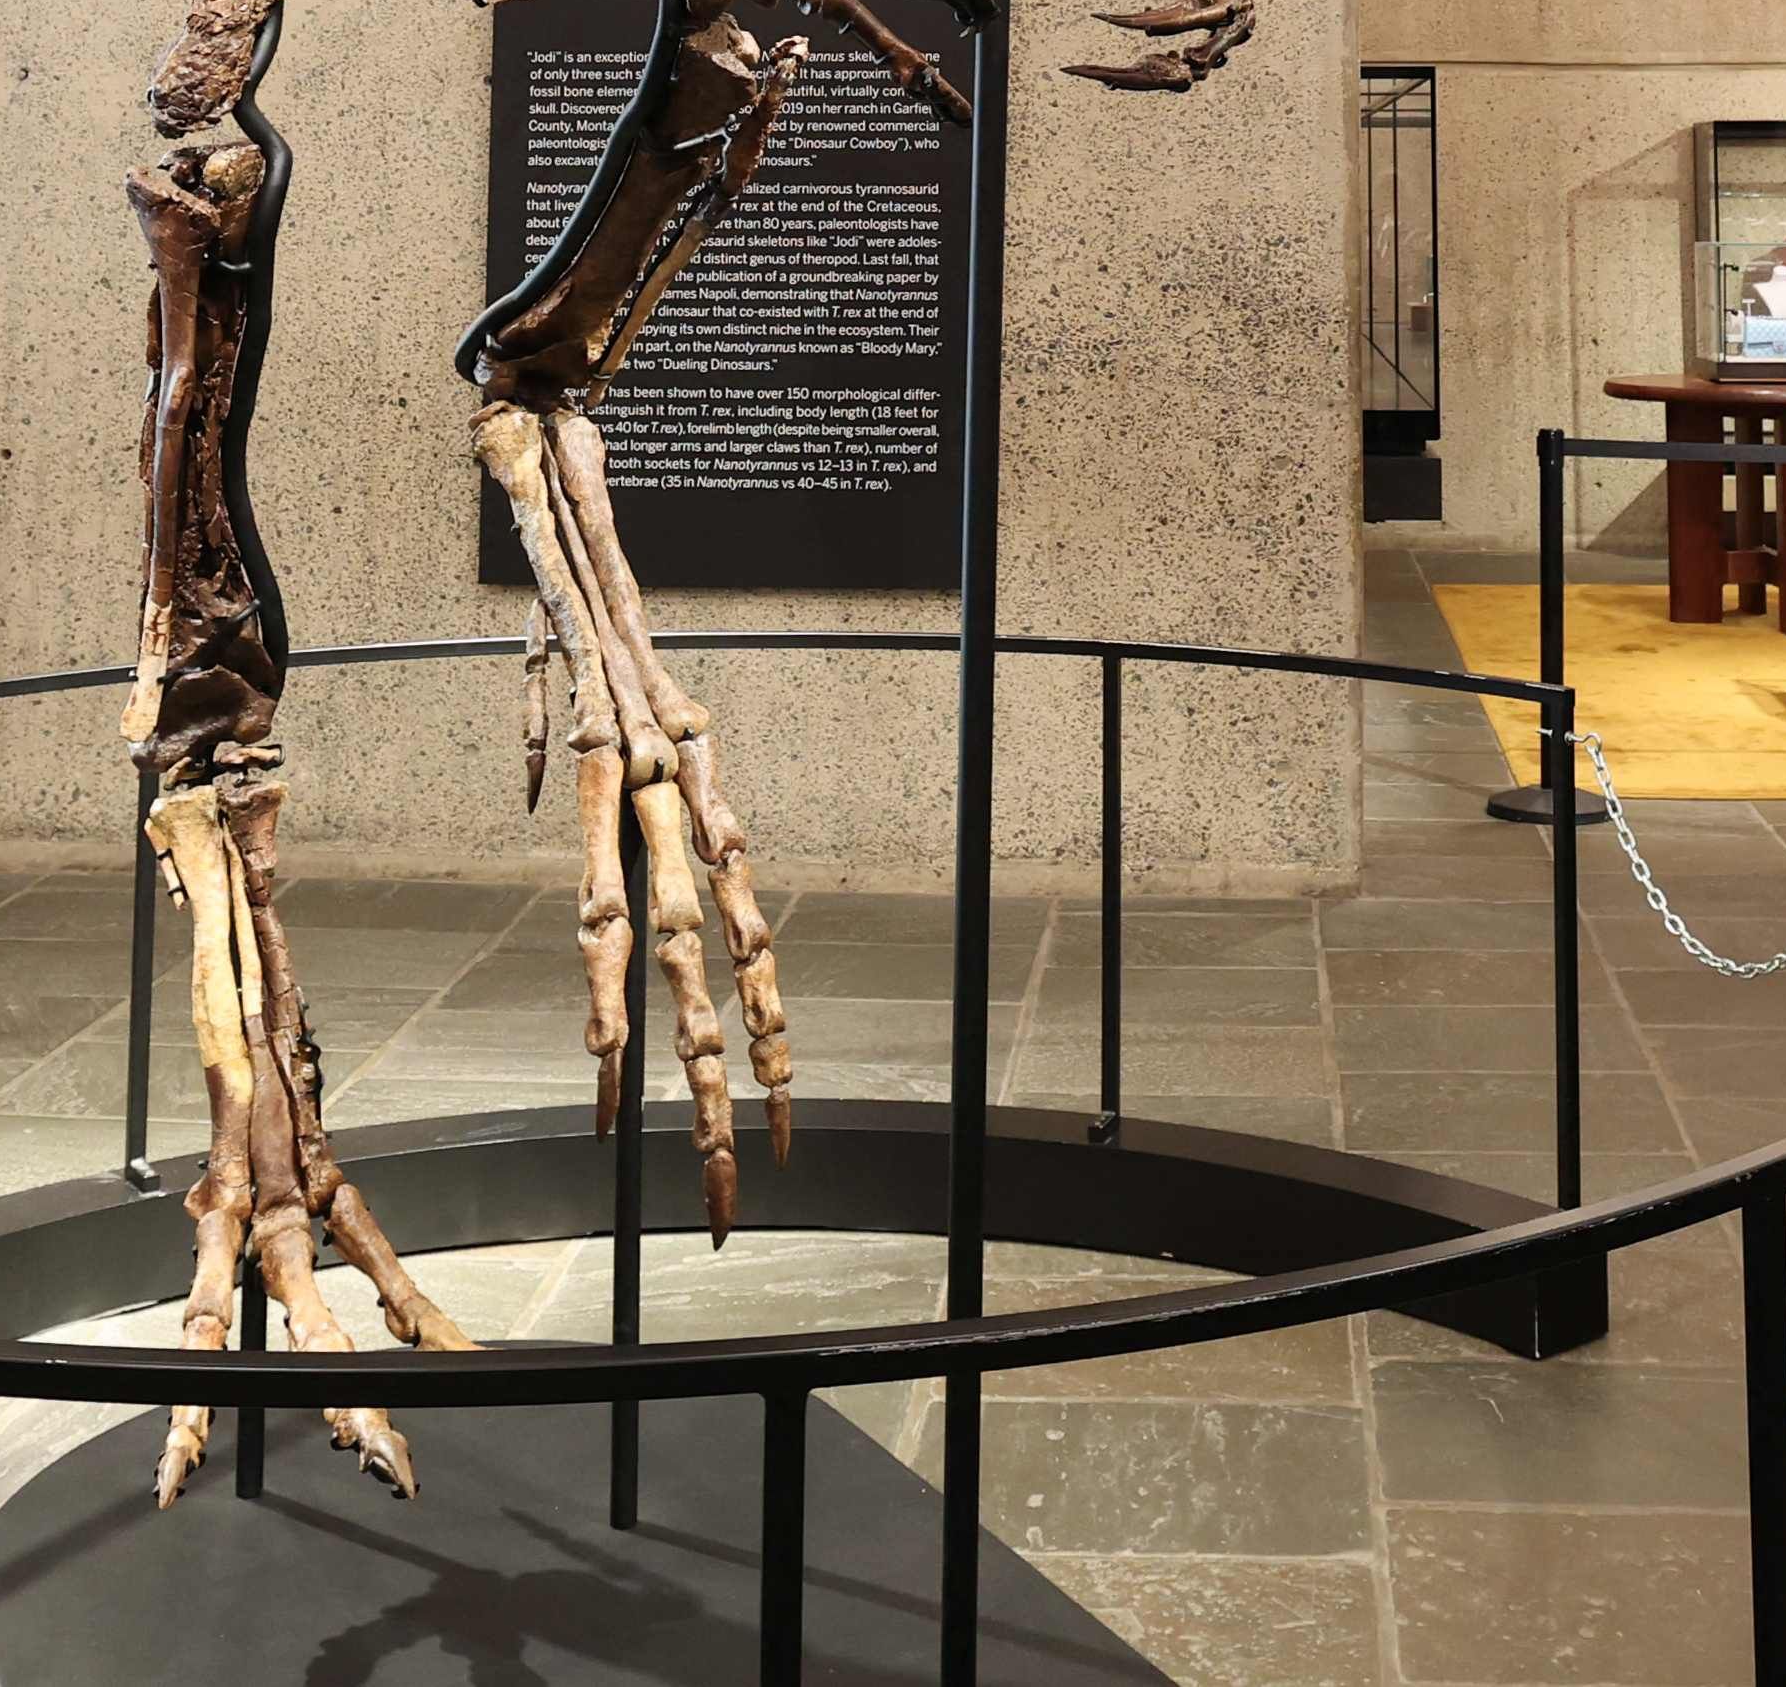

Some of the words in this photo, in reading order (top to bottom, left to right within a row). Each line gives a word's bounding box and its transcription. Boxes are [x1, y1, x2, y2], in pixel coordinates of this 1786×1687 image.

[564, 52, 574, 62] is
[577, 54, 591, 62] an
[530, 68, 542, 80] of
[544, 68, 568, 82] only
[572, 69, 602, 80] three
[605, 69, 632, 80] such
[800, 68, 811, 79] It
[811, 68, 832, 79] has
[530, 86, 560, 97] fossil
[564, 86, 594, 97] bone
[831, 85, 879, 99] virtually
[529, 103, 558, 114] skull.
[561, 103, 625, 115] Discovered
[806, 105, 820, 114] on
[823, 103, 842, 114] her
[845, 103, 878, 114] ranch
[880, 103, 891, 113] in
[790, 120, 804, 134] by
[807, 120, 865, 131] renowned
[869, 121, 939, 131] commercial
[766, 137, 786, 149] the
[915, 138, 939, 149] who
[528, 155, 552, 165] also
[783, 183, 852, 194] carnivorous
[856, 184, 939, 197] tyrannosaurid
[527, 199, 551, 211] that
[739, 200, 759, 211] rex
[762, 201, 774, 211] at
[778, 200, 798, 211] the
[801, 201, 824, 211] end
[828, 200, 840, 212] of
[844, 201, 863, 212] the
[526, 217, 560, 228] about
[734, 218, 761, 229] than
[762, 217, 779, 229] 80
[819, 218, 908, 232] paleontologists
[911, 218, 939, 230] have
[747, 235, 804, 247] skeletons
[807, 236, 827, 247] like
[866, 238, 895, 247] were
[898, 236, 941, 247] adoles-
[703, 253, 747, 264] distinct
[750, 255, 786, 267] genus
[788, 253, 800, 264] of
[803, 253, 860, 267] theropod.
[863, 253, 889, 265] Last
[915, 254, 939, 265] that
[697, 270, 762, 283] publication
[765, 270, 777, 281] of
[779, 273, 786, 281] a
[789, 271, 884, 285] groundbreaking
[887, 274, 921, 285] paper
[924, 272, 938, 285] by
[742, 288, 828, 302] demonstrating
[828, 289, 854, 301] that
[854, 289, 938, 303] Nanotyrannus
[656, 303, 710, 316] dinosaur
[713, 305, 736, 317] that
[739, 306, 801, 317] co-existed
[803, 306, 829, 317] with
[843, 309, 861, 318] rex
[864, 307, 876, 318] at
[882, 307, 899, 318] the
[901, 307, 924, 318] end
[926, 307, 938, 318] of
[680, 323, 694, 334] its
[696, 326, 721, 334] own
[722, 323, 767, 335] distinct
[769, 324, 801, 335] niche
[804, 324, 814, 335] in
[817, 324, 836, 335] the
[839, 325, 907, 338] ecosystem.
[908, 324, 940, 336] Their
[632, 339, 643, 351] in
[675, 343, 690, 352] on
[693, 341, 712, 352] the
[714, 341, 796, 355] Nanotyrannus
[799, 342, 838, 353] known
[840, 345, 854, 353] as
[634, 358, 655, 369] two
[608, 385, 630, 397] has
[634, 386, 664, 398] been
[667, 387, 706, 398] shown
[710, 388, 722, 398] to
[725, 387, 754, 399] have
[757, 390, 784, 399] over
[787, 387, 809, 399] 150
[813, 388, 900, 402] morphological
[903, 389, 940, 400] differ-
[657, 405, 664, 415] it
[668, 404, 697, 416] from
[738, 405, 793, 419] including
[796, 406, 826, 420] body
[830, 406, 868, 420] length
[872, 406, 891, 419] (18
[895, 407, 918, 418] feet
[922, 407, 939, 418] for
[601, 424, 615, 435] vs
[614, 421, 632, 433] 40
[633, 422, 650, 433] for
[687, 422, 735, 434] forelimb
[735, 423, 772, 437] length
[772, 423, 820, 437] (despite
[821, 424, 854, 438] being
[854, 425, 898, 437] smaller
[604, 439, 627, 453] had
[631, 439, 668, 454] longer
[670, 443, 701, 452] arms
[704, 441, 727, 452] and
[730, 441, 764, 455] larger
[767, 441, 800, 453] claws
[803, 442, 830, 453] than
[875, 443, 923, 454] number
[926, 443, 937, 454] of
[609, 458, 641, 468] tooth
[645, 458, 691, 469] sockets
[694, 458, 711, 470] for
[714, 458, 798, 473] Nanotyrannus
[801, 462, 815, 471] vs
[857, 460, 867, 471] in
[913, 461, 936, 472] and
[661, 475, 682, 489] (35
[684, 476, 694, 487] in
[697, 476, 779, 490] Nanotyrannus
[782, 480, 796, 489] vs
[841, 478, 851, 489] in
